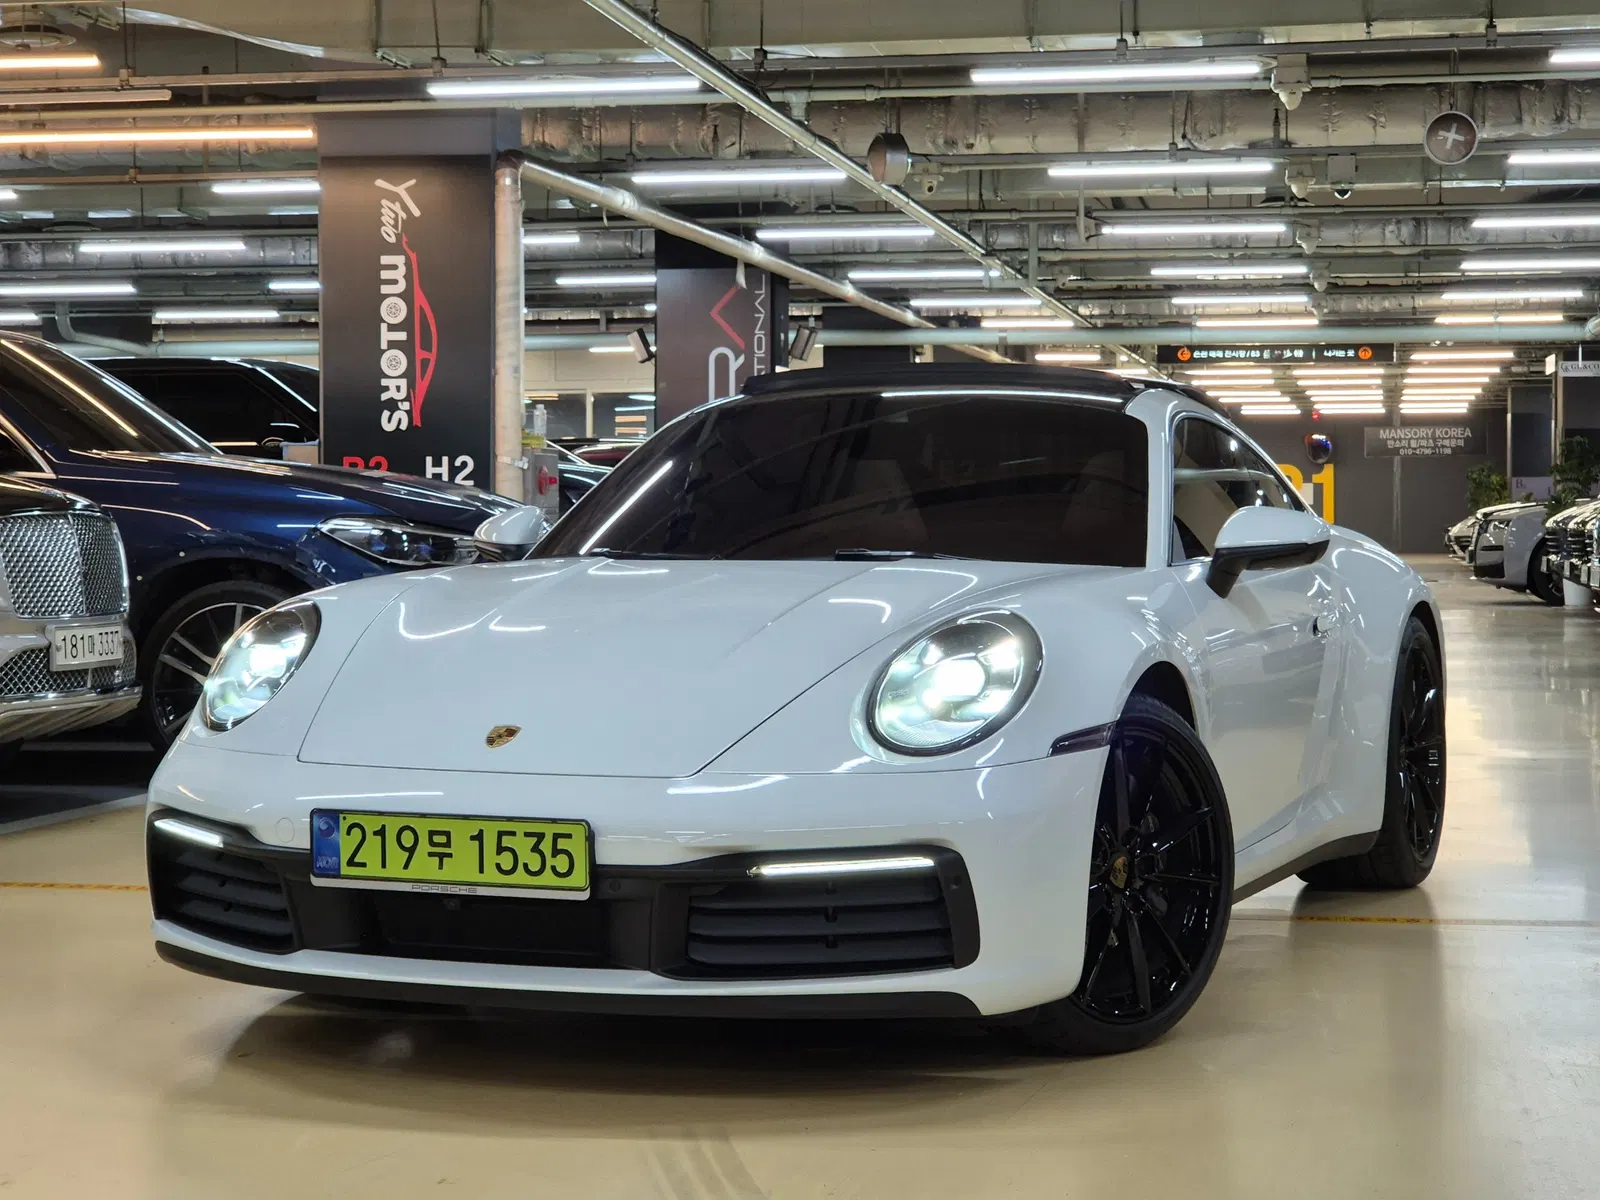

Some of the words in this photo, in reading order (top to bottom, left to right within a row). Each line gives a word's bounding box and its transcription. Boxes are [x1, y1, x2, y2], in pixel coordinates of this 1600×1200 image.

[1379, 428, 1434, 439] MANSORY
[1435, 427, 1472, 438] KOREA
[425, 455, 475, 486] H2
[346, 822, 453, 870] 219무
[469, 828, 575, 878] 1535
[411, 884, 478, 894] PORSCHE
